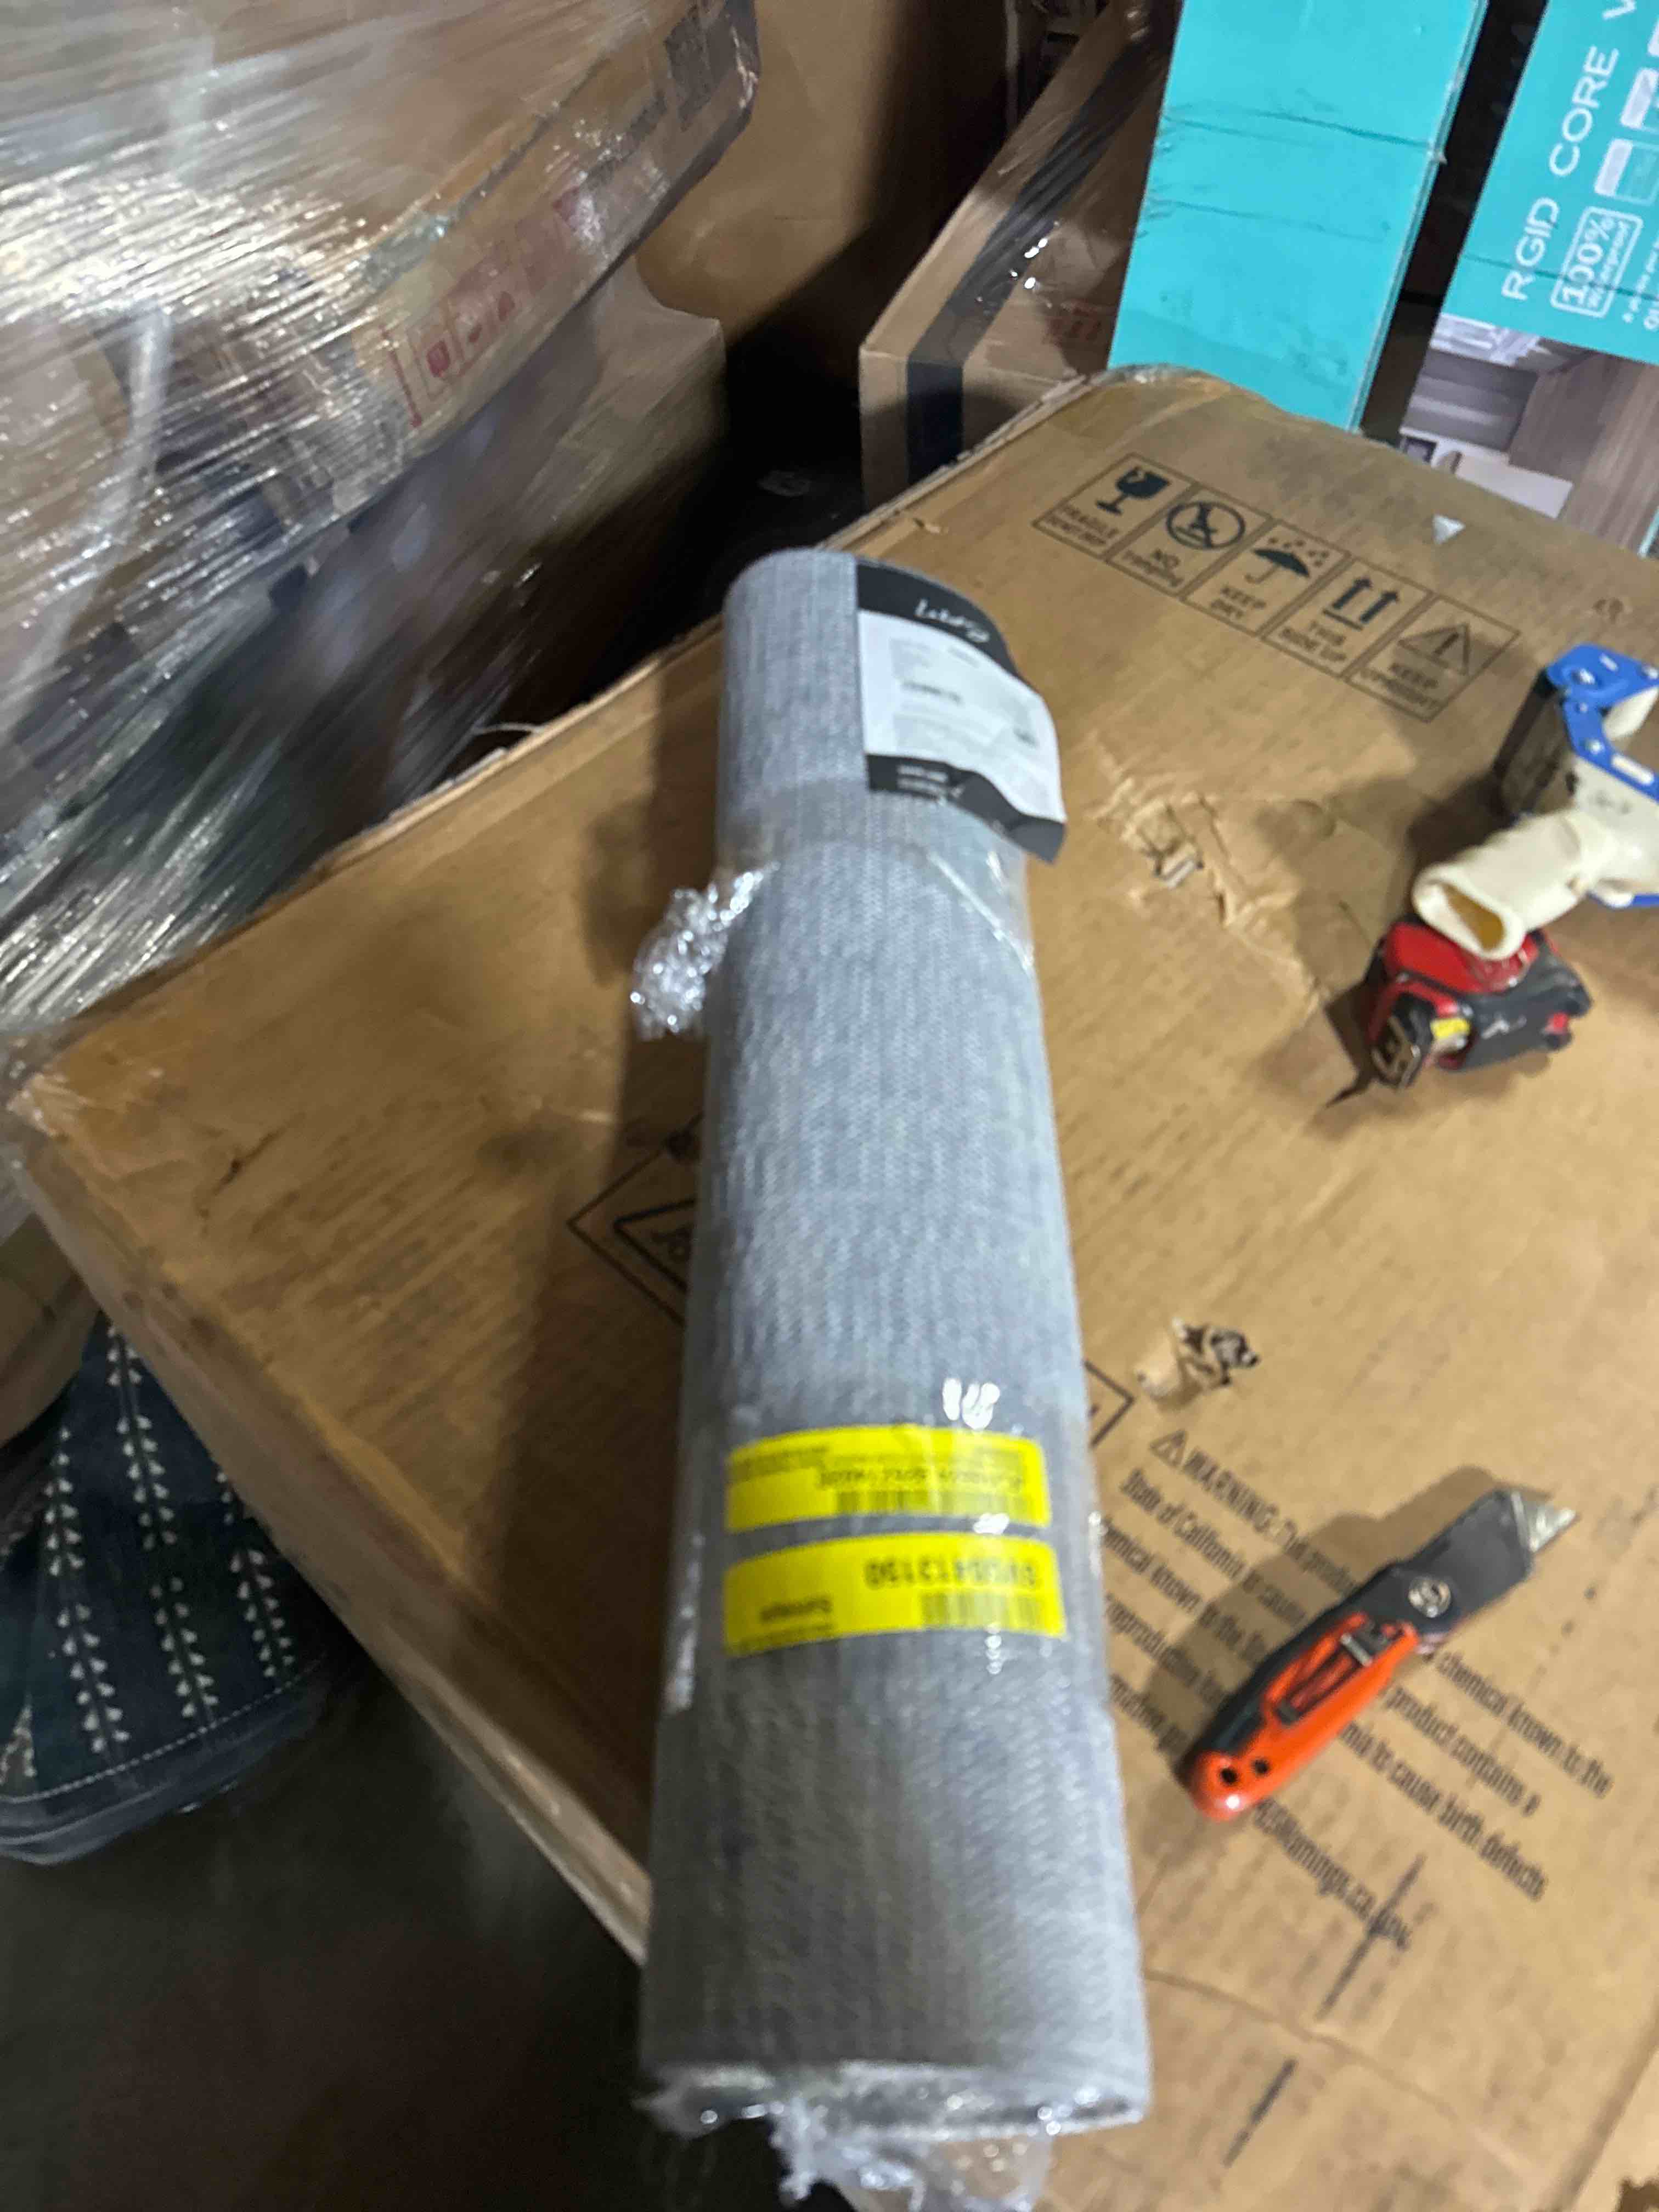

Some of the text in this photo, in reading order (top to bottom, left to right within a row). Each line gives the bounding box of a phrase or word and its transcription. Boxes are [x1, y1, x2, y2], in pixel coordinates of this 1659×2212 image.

[1549, 45, 1619, 177] CORE
[1220, 583, 1266, 610] KEEP
[1505, 1704, 1564, 1758] known
[1575, 1759, 1613, 1798] the
